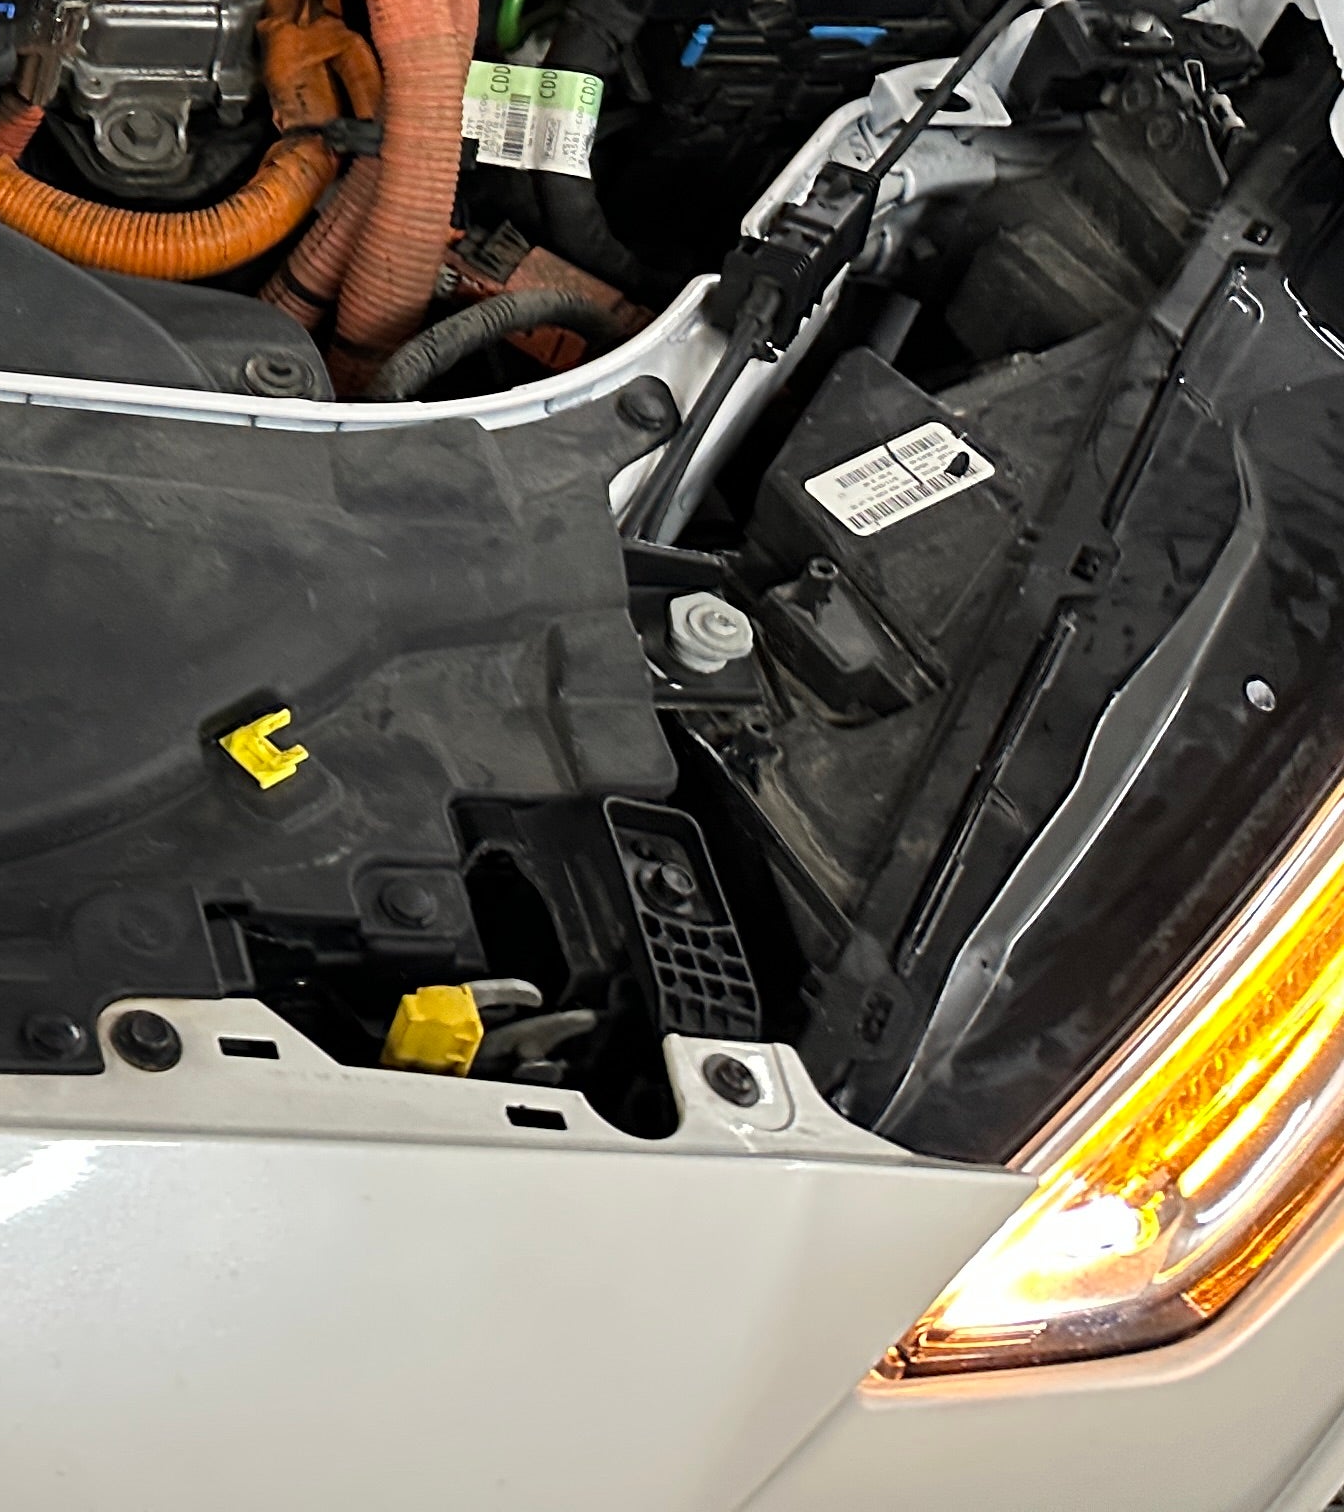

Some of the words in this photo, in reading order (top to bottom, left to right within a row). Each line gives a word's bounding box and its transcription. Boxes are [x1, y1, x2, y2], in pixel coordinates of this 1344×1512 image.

[490, 65, 511, 94] CDD
[540, 70, 558, 99] CDD
[580, 76, 598, 106] CDD
